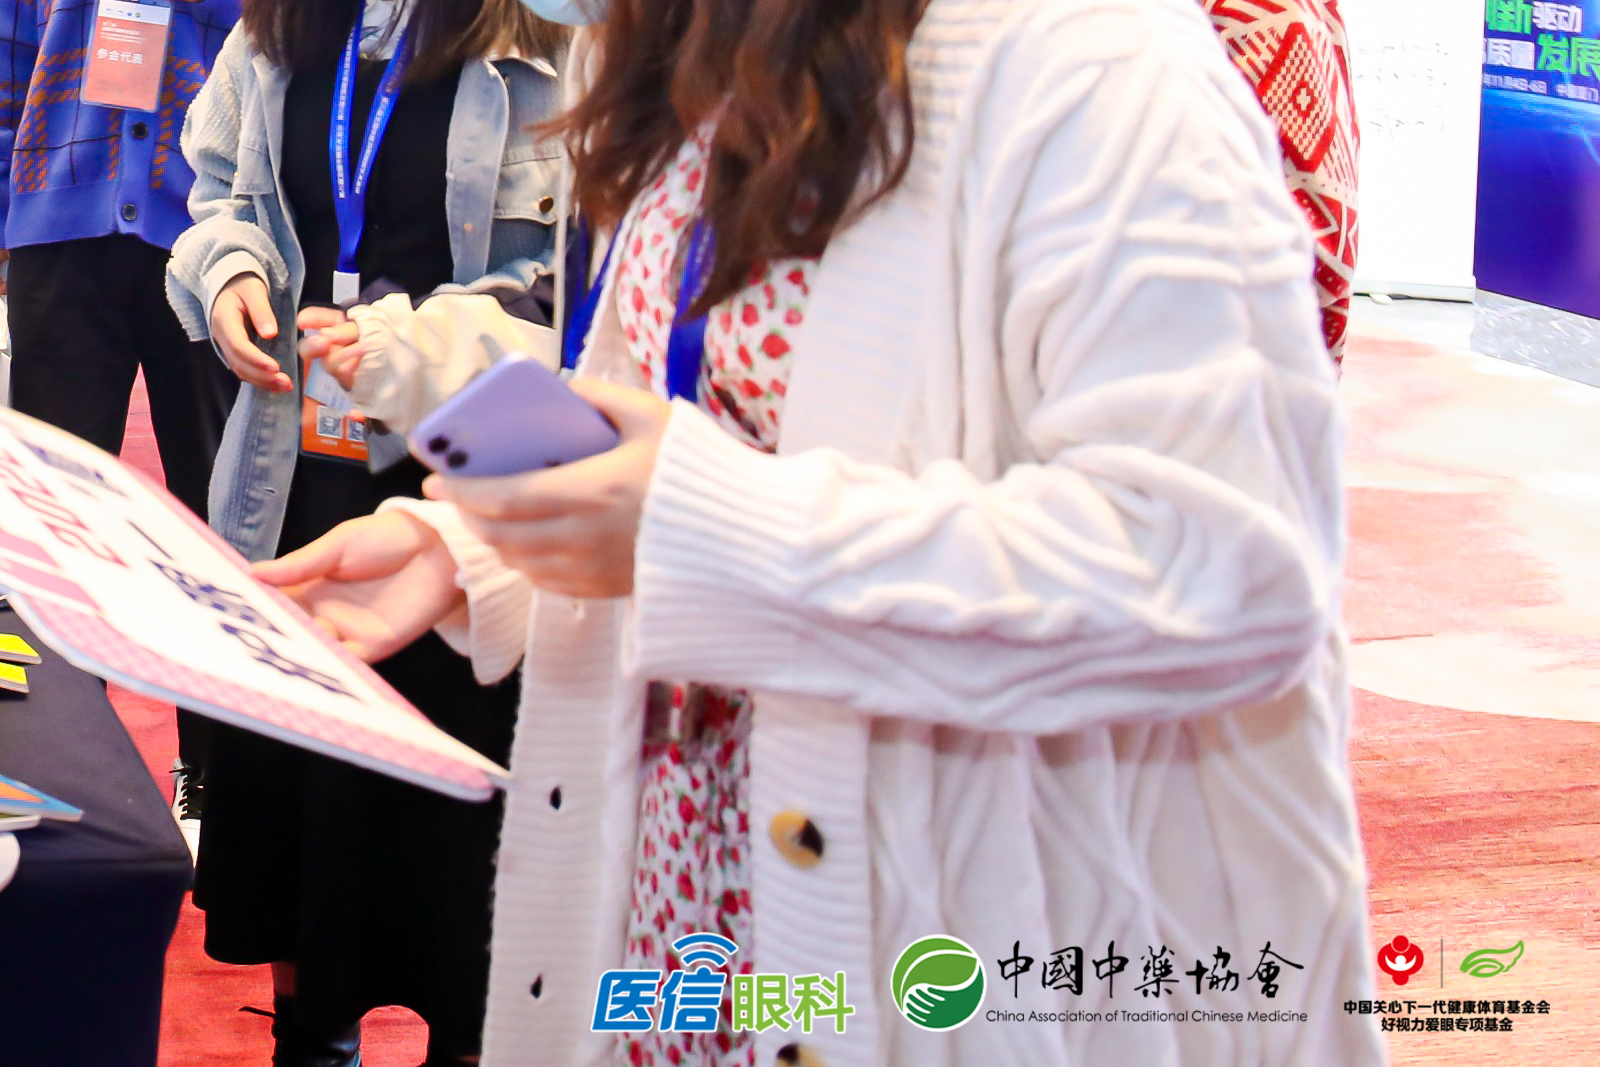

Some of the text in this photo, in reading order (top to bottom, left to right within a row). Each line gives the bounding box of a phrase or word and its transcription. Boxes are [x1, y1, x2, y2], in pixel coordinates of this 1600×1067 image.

[97, 48, 143, 65] 参会代表
[1483, 34, 1600, 80] 质量发展
